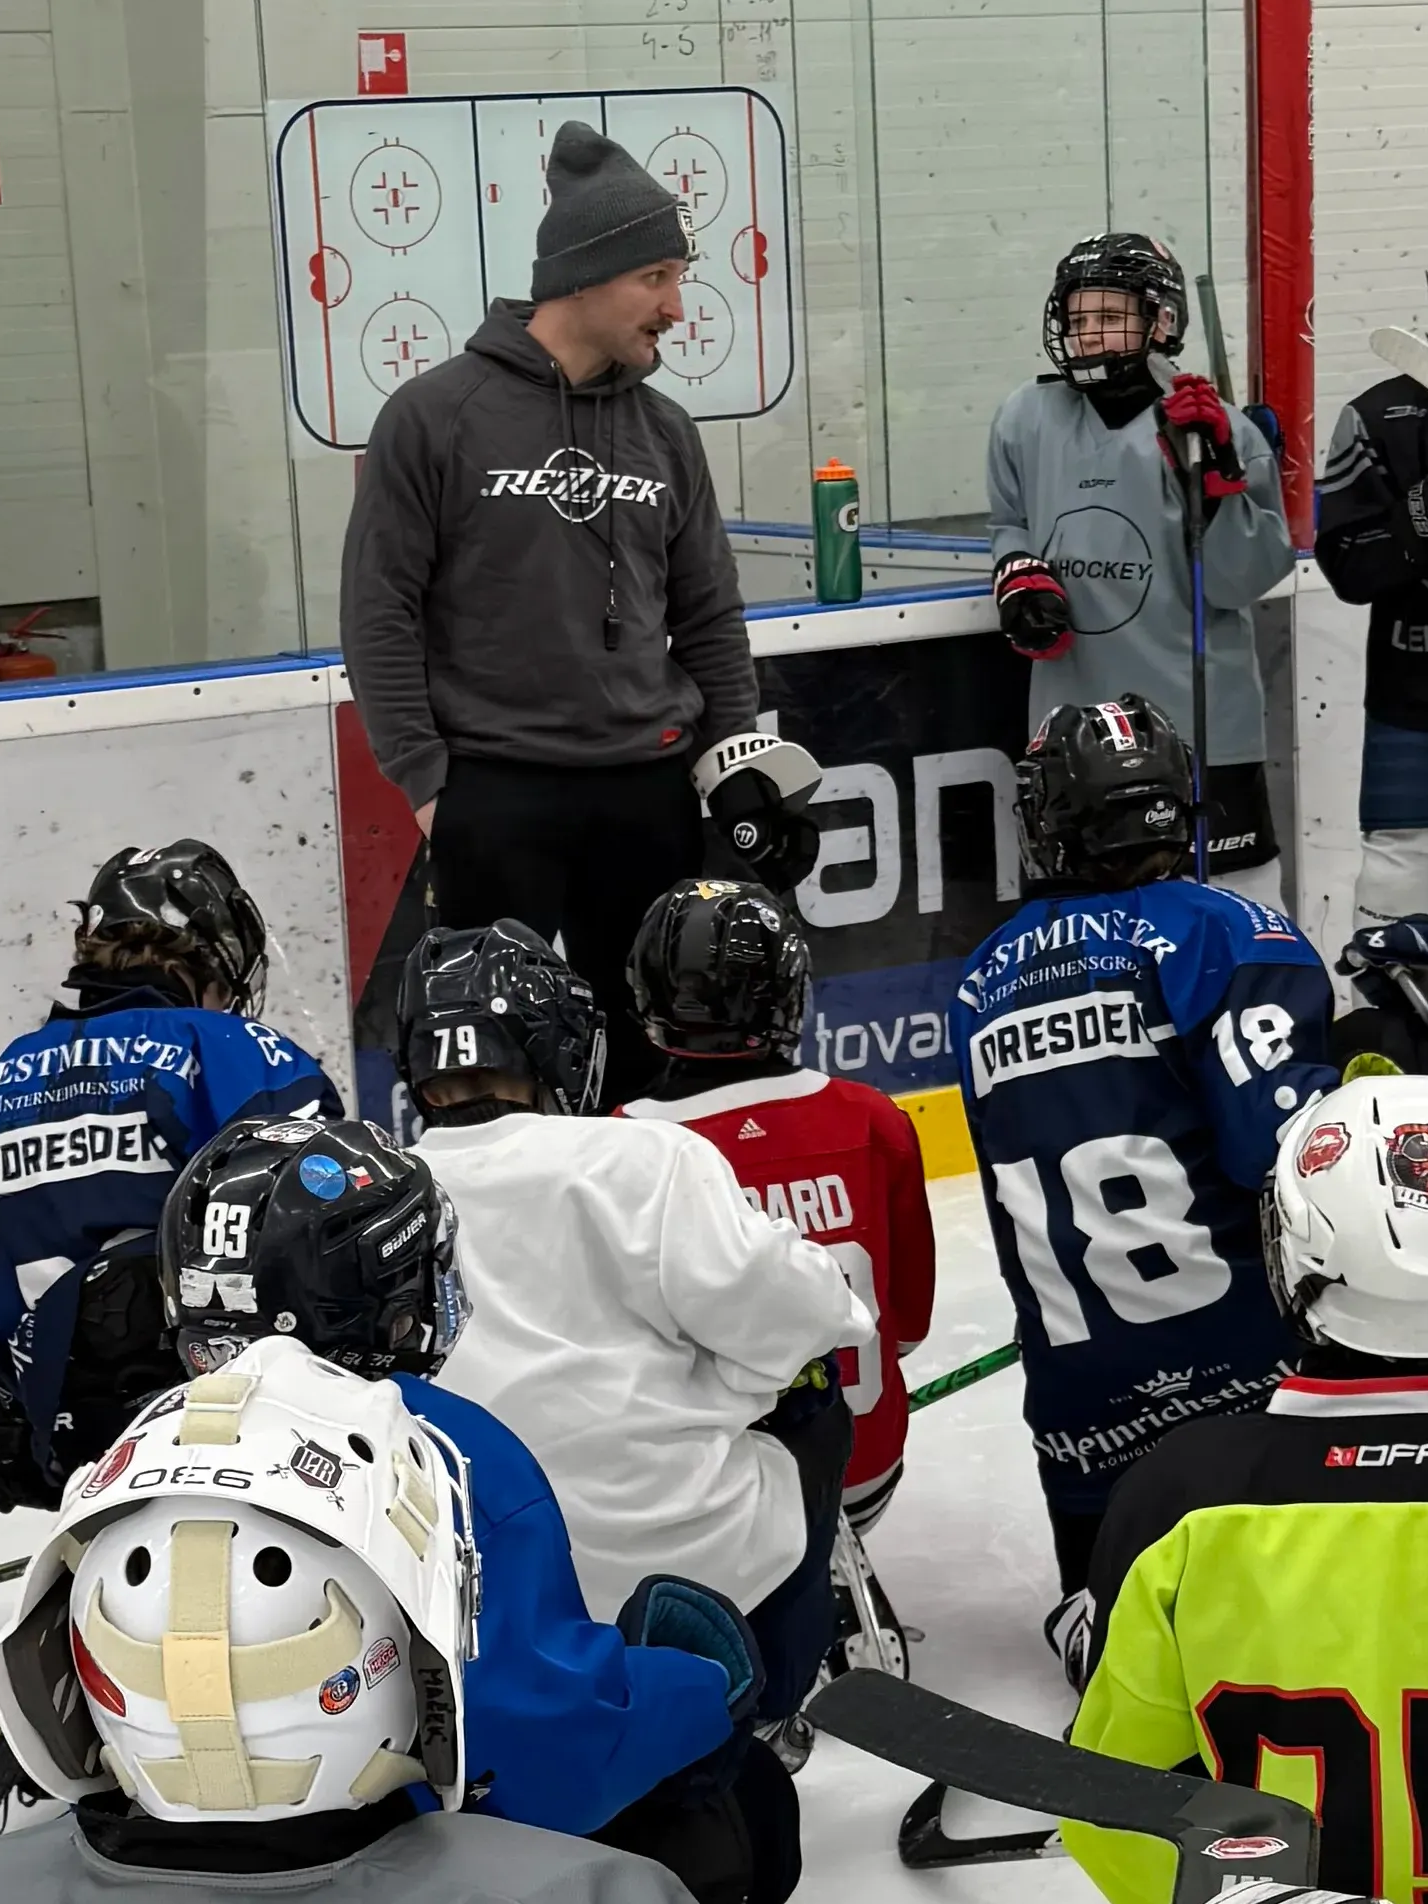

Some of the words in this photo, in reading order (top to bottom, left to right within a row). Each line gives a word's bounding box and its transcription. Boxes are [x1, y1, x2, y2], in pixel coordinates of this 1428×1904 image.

[433, 1024, 478, 1070] 79
[1211, 1003, 1296, 1088] 18
[213, 1202, 262, 1260] 83
[380, 1211, 429, 1260] BAUER
[992, 1134, 1233, 1347] 18
